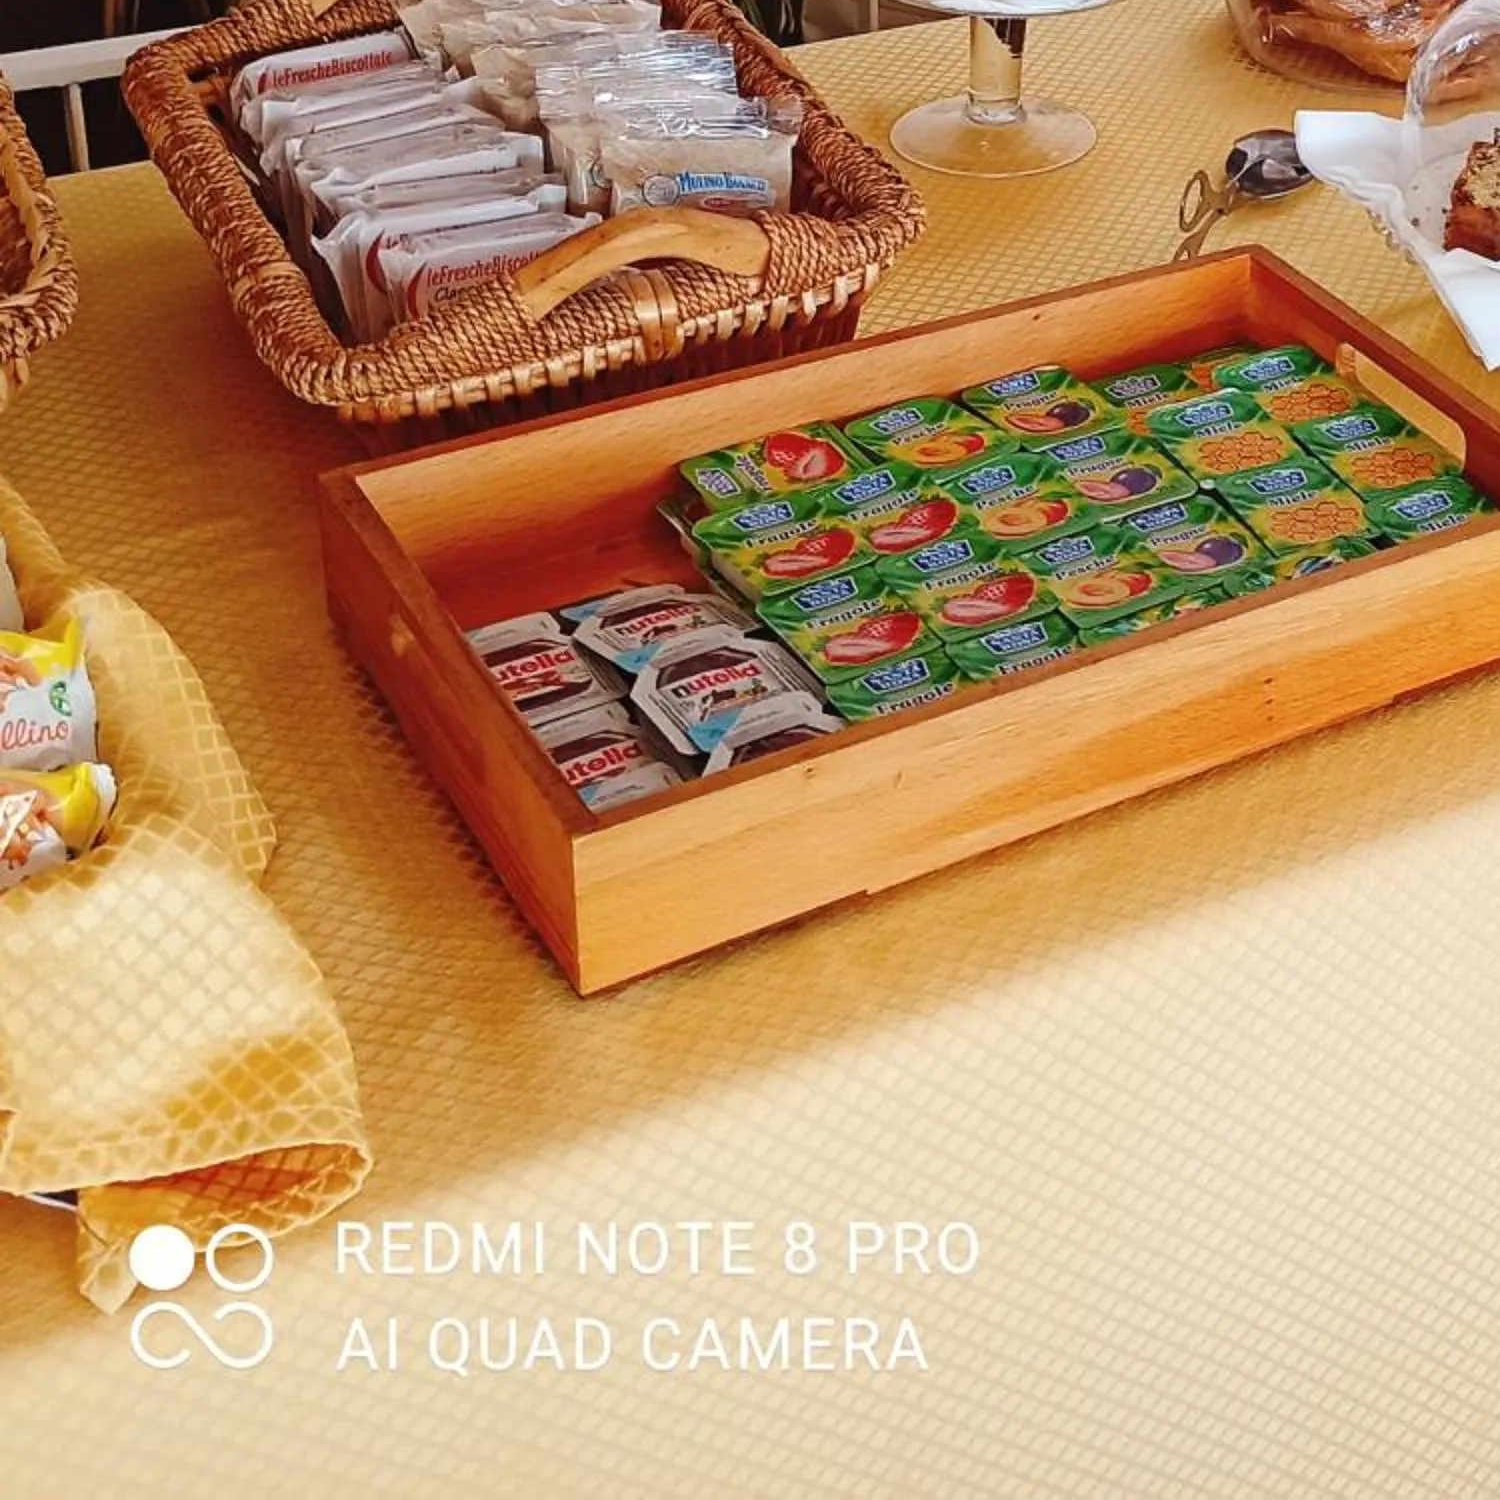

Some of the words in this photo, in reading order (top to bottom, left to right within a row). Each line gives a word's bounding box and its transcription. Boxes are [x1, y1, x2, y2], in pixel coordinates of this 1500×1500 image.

[976, 483, 1035, 511] Pesche
[924, 561, 998, 591] Fragole
[1055, 555, 1115, 581] Pesche
[615, 604, 700, 637] nutella
[805, 598, 883, 630] Fragole
[999, 644, 1073, 676] Fragole
[671, 662, 763, 699] nutella
[875, 681, 955, 715] Fragole
